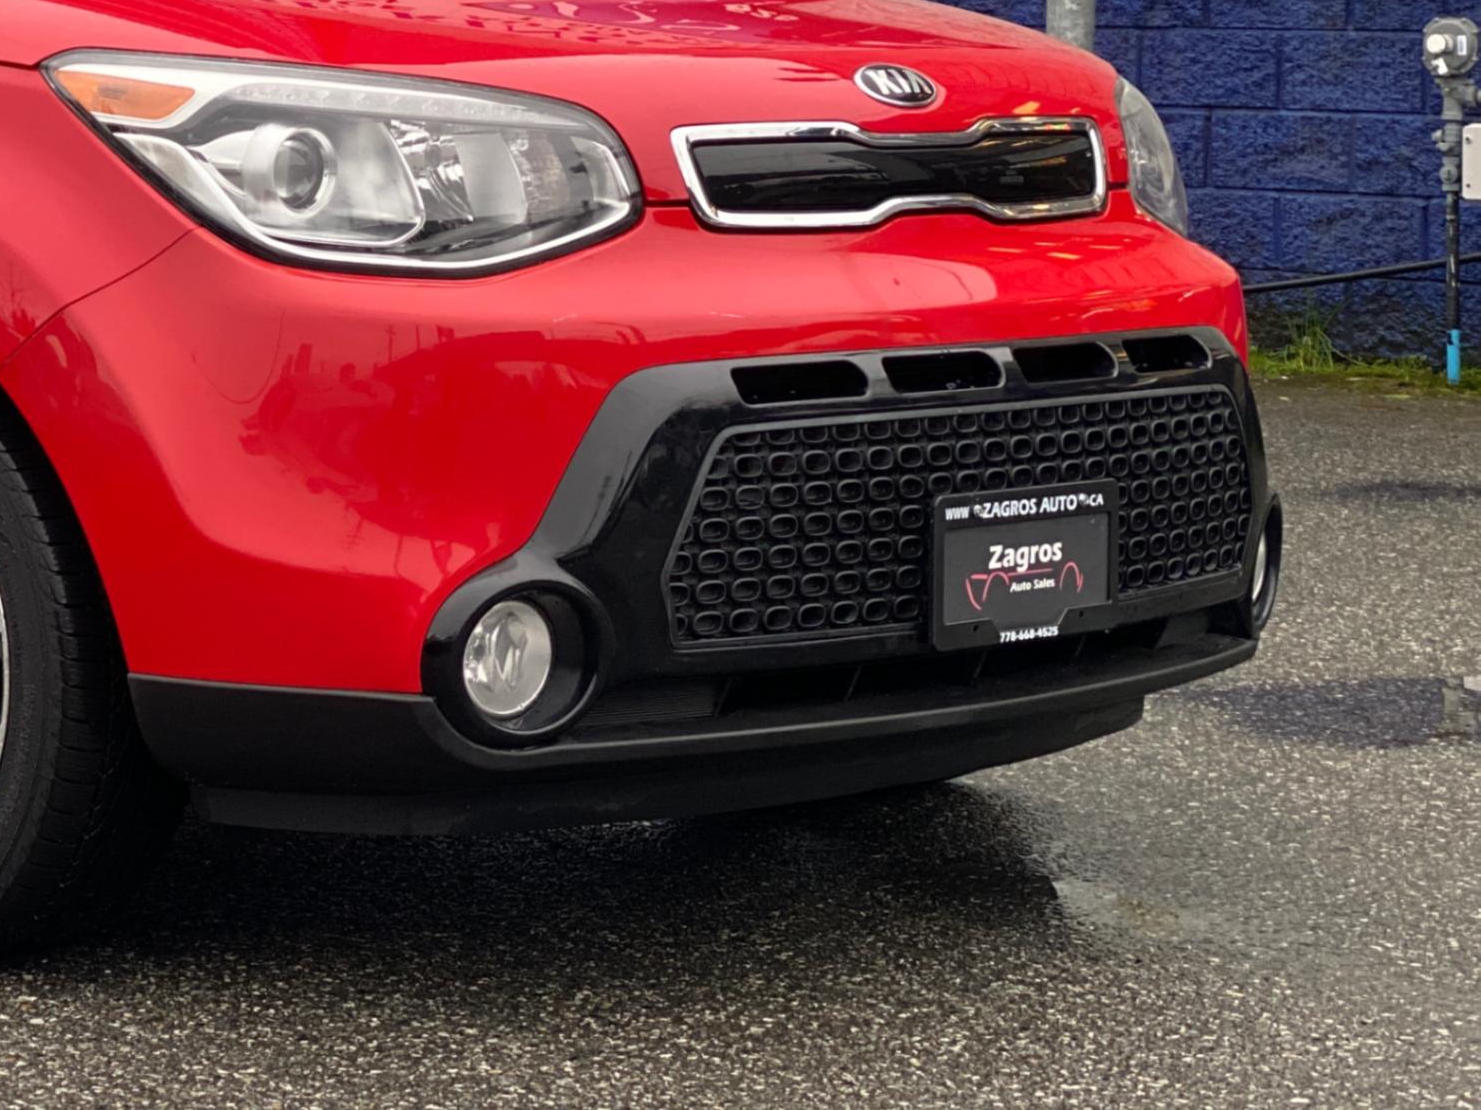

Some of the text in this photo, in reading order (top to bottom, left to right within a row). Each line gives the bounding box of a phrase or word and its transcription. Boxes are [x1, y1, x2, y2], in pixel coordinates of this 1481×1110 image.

[863, 68, 934, 96] KIA
[981, 498, 1038, 519] ZAGROS
[1039, 494, 1078, 513] AUTO
[988, 541, 1063, 573] Zagros
[1009, 577, 1056, 593] Auto Sales
[999, 625, 1059, 644] 778-668-4525
